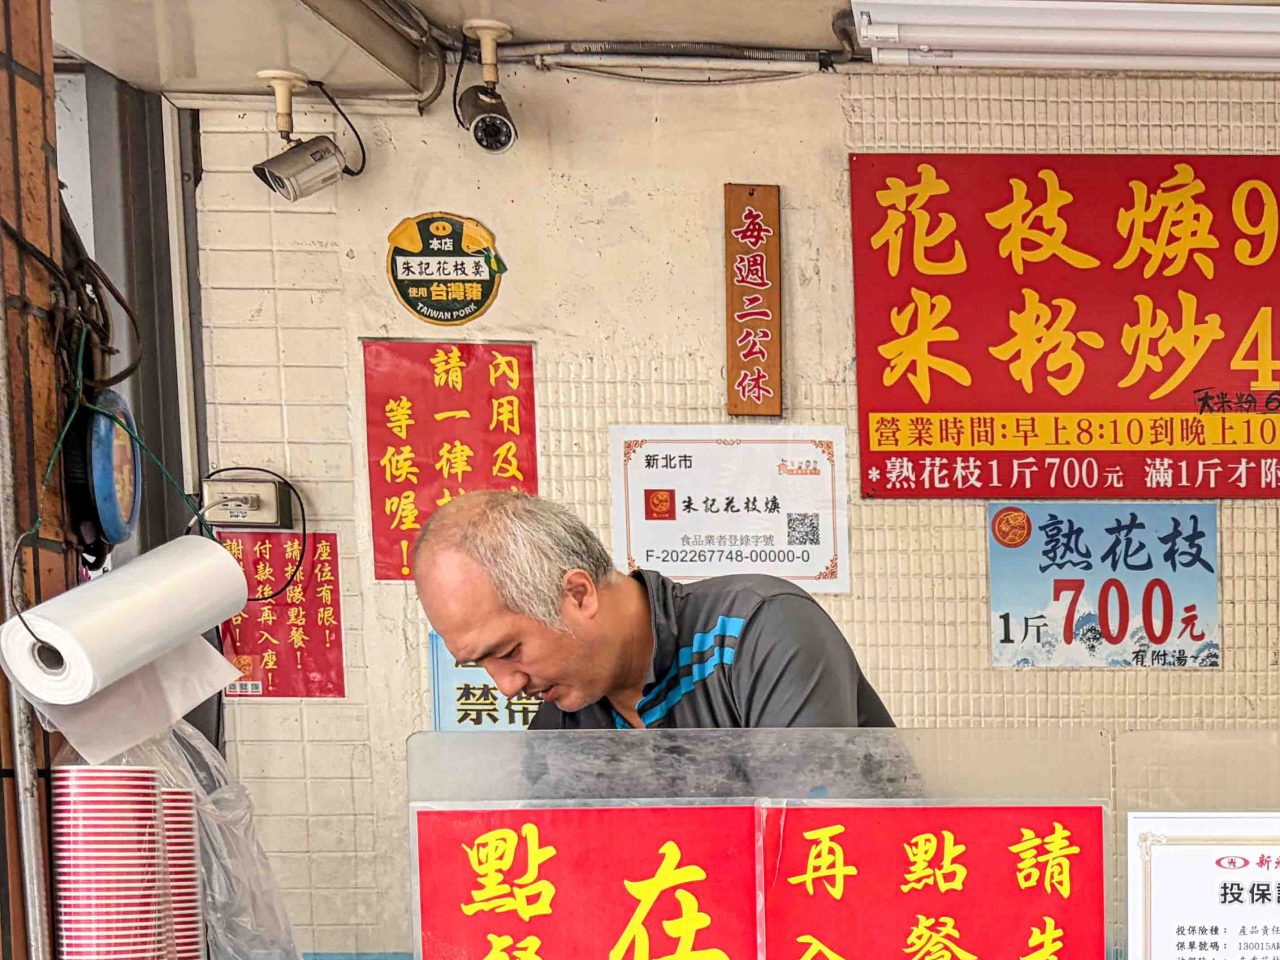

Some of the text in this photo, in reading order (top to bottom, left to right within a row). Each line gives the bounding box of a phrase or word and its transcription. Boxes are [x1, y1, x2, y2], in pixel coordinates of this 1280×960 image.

[429, 238, 454, 251] 本店
[408, 282, 482, 301] 使用 台灣豬
[416, 302, 477, 319] TAIWAN PORK
[731, 206, 774, 404] 每週二公休
[877, 288, 1225, 404] 米粉炒
[489, 351, 524, 495] 內用及
[644, 454, 693, 470] 新北市
[1038, 511, 1214, 574] 熟花枝
[646, 550, 811, 563] F-202267748-00000-0
